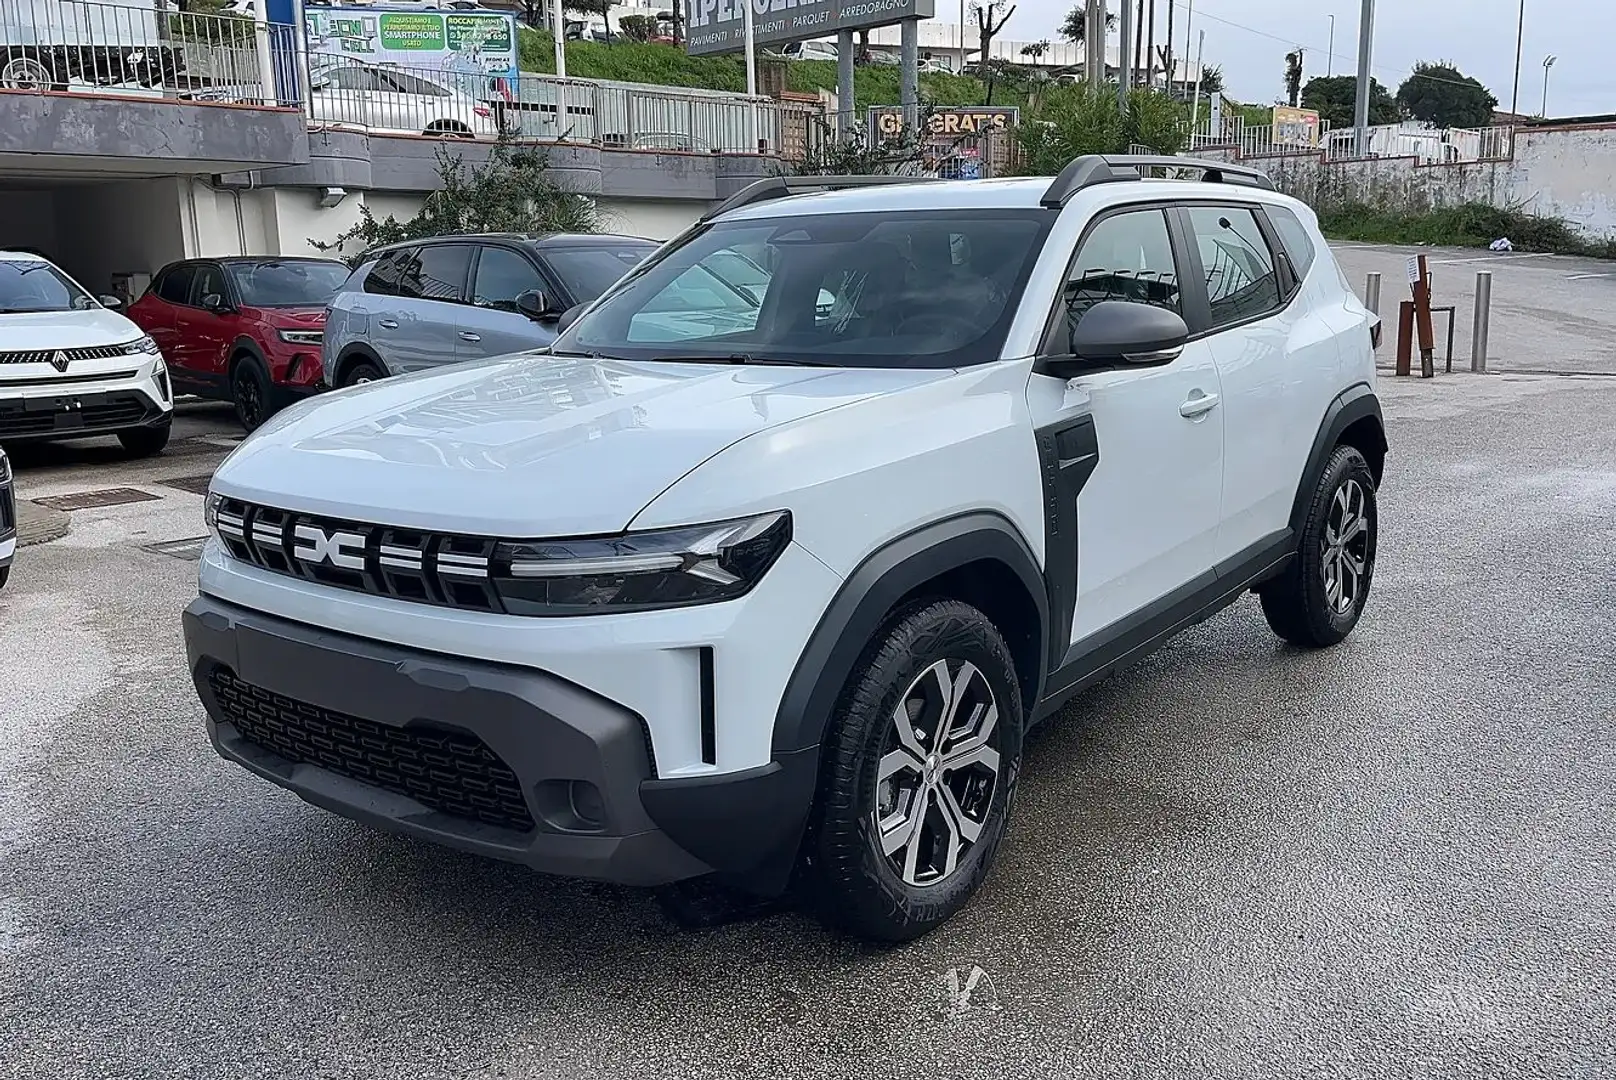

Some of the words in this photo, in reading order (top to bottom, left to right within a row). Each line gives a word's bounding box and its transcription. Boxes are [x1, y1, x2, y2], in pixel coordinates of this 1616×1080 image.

[383, 31, 441, 39] SMARTPHONE
[690, 31, 728, 46] PAVIMENTI
[735, 20, 786, 38] RIVTIMENTI
[792, 10, 831, 28] PARQUET
[839, 0, 909, 19] ARREDOBAGNO
